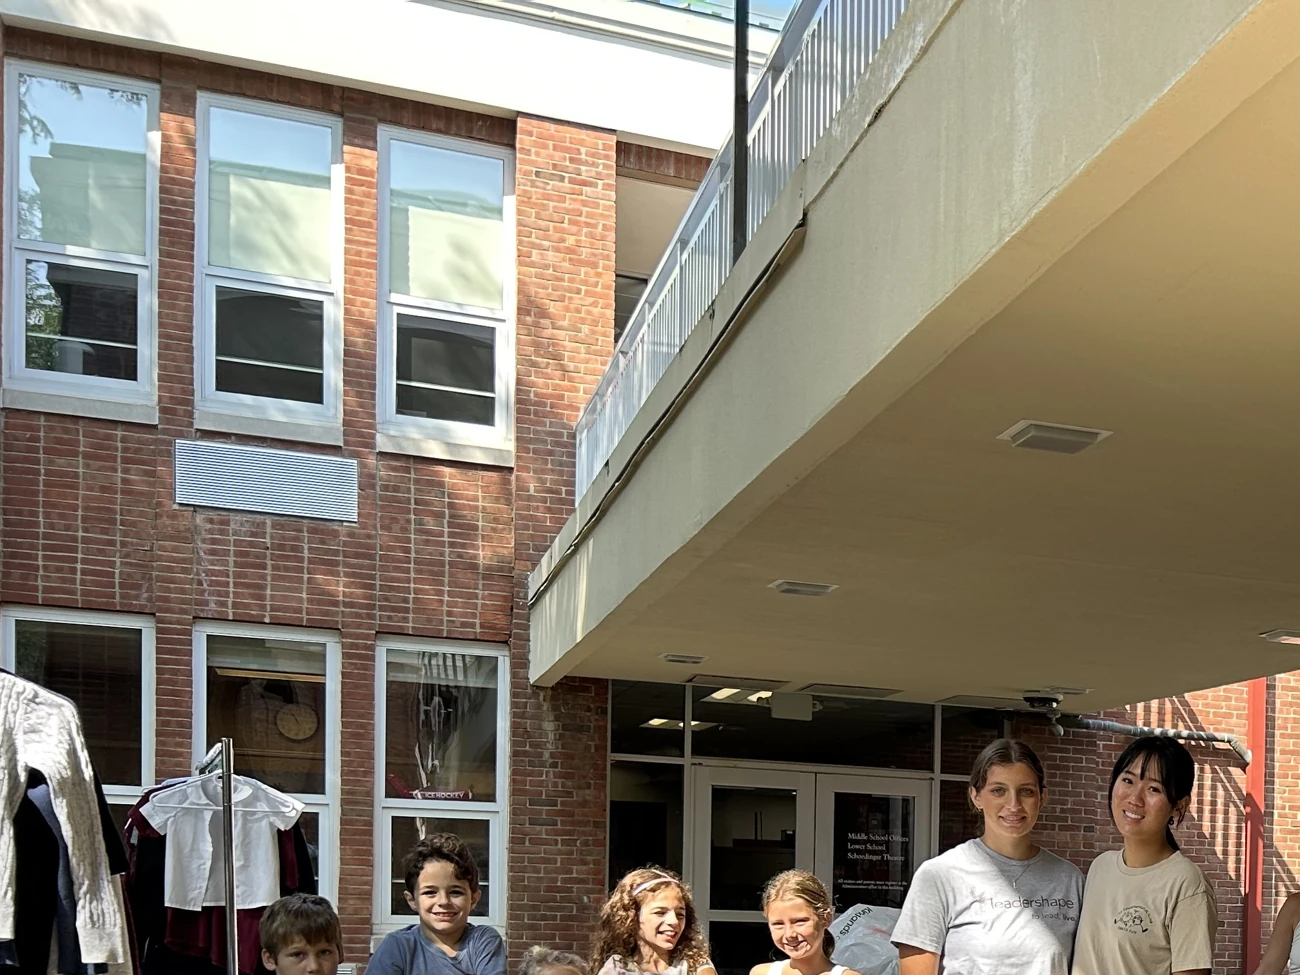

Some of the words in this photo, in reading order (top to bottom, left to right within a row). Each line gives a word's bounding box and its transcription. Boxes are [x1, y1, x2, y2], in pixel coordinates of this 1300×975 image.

[847, 832, 868, 840] Middle
[847, 842, 865, 850] Lower
[866, 843, 886, 851] School
